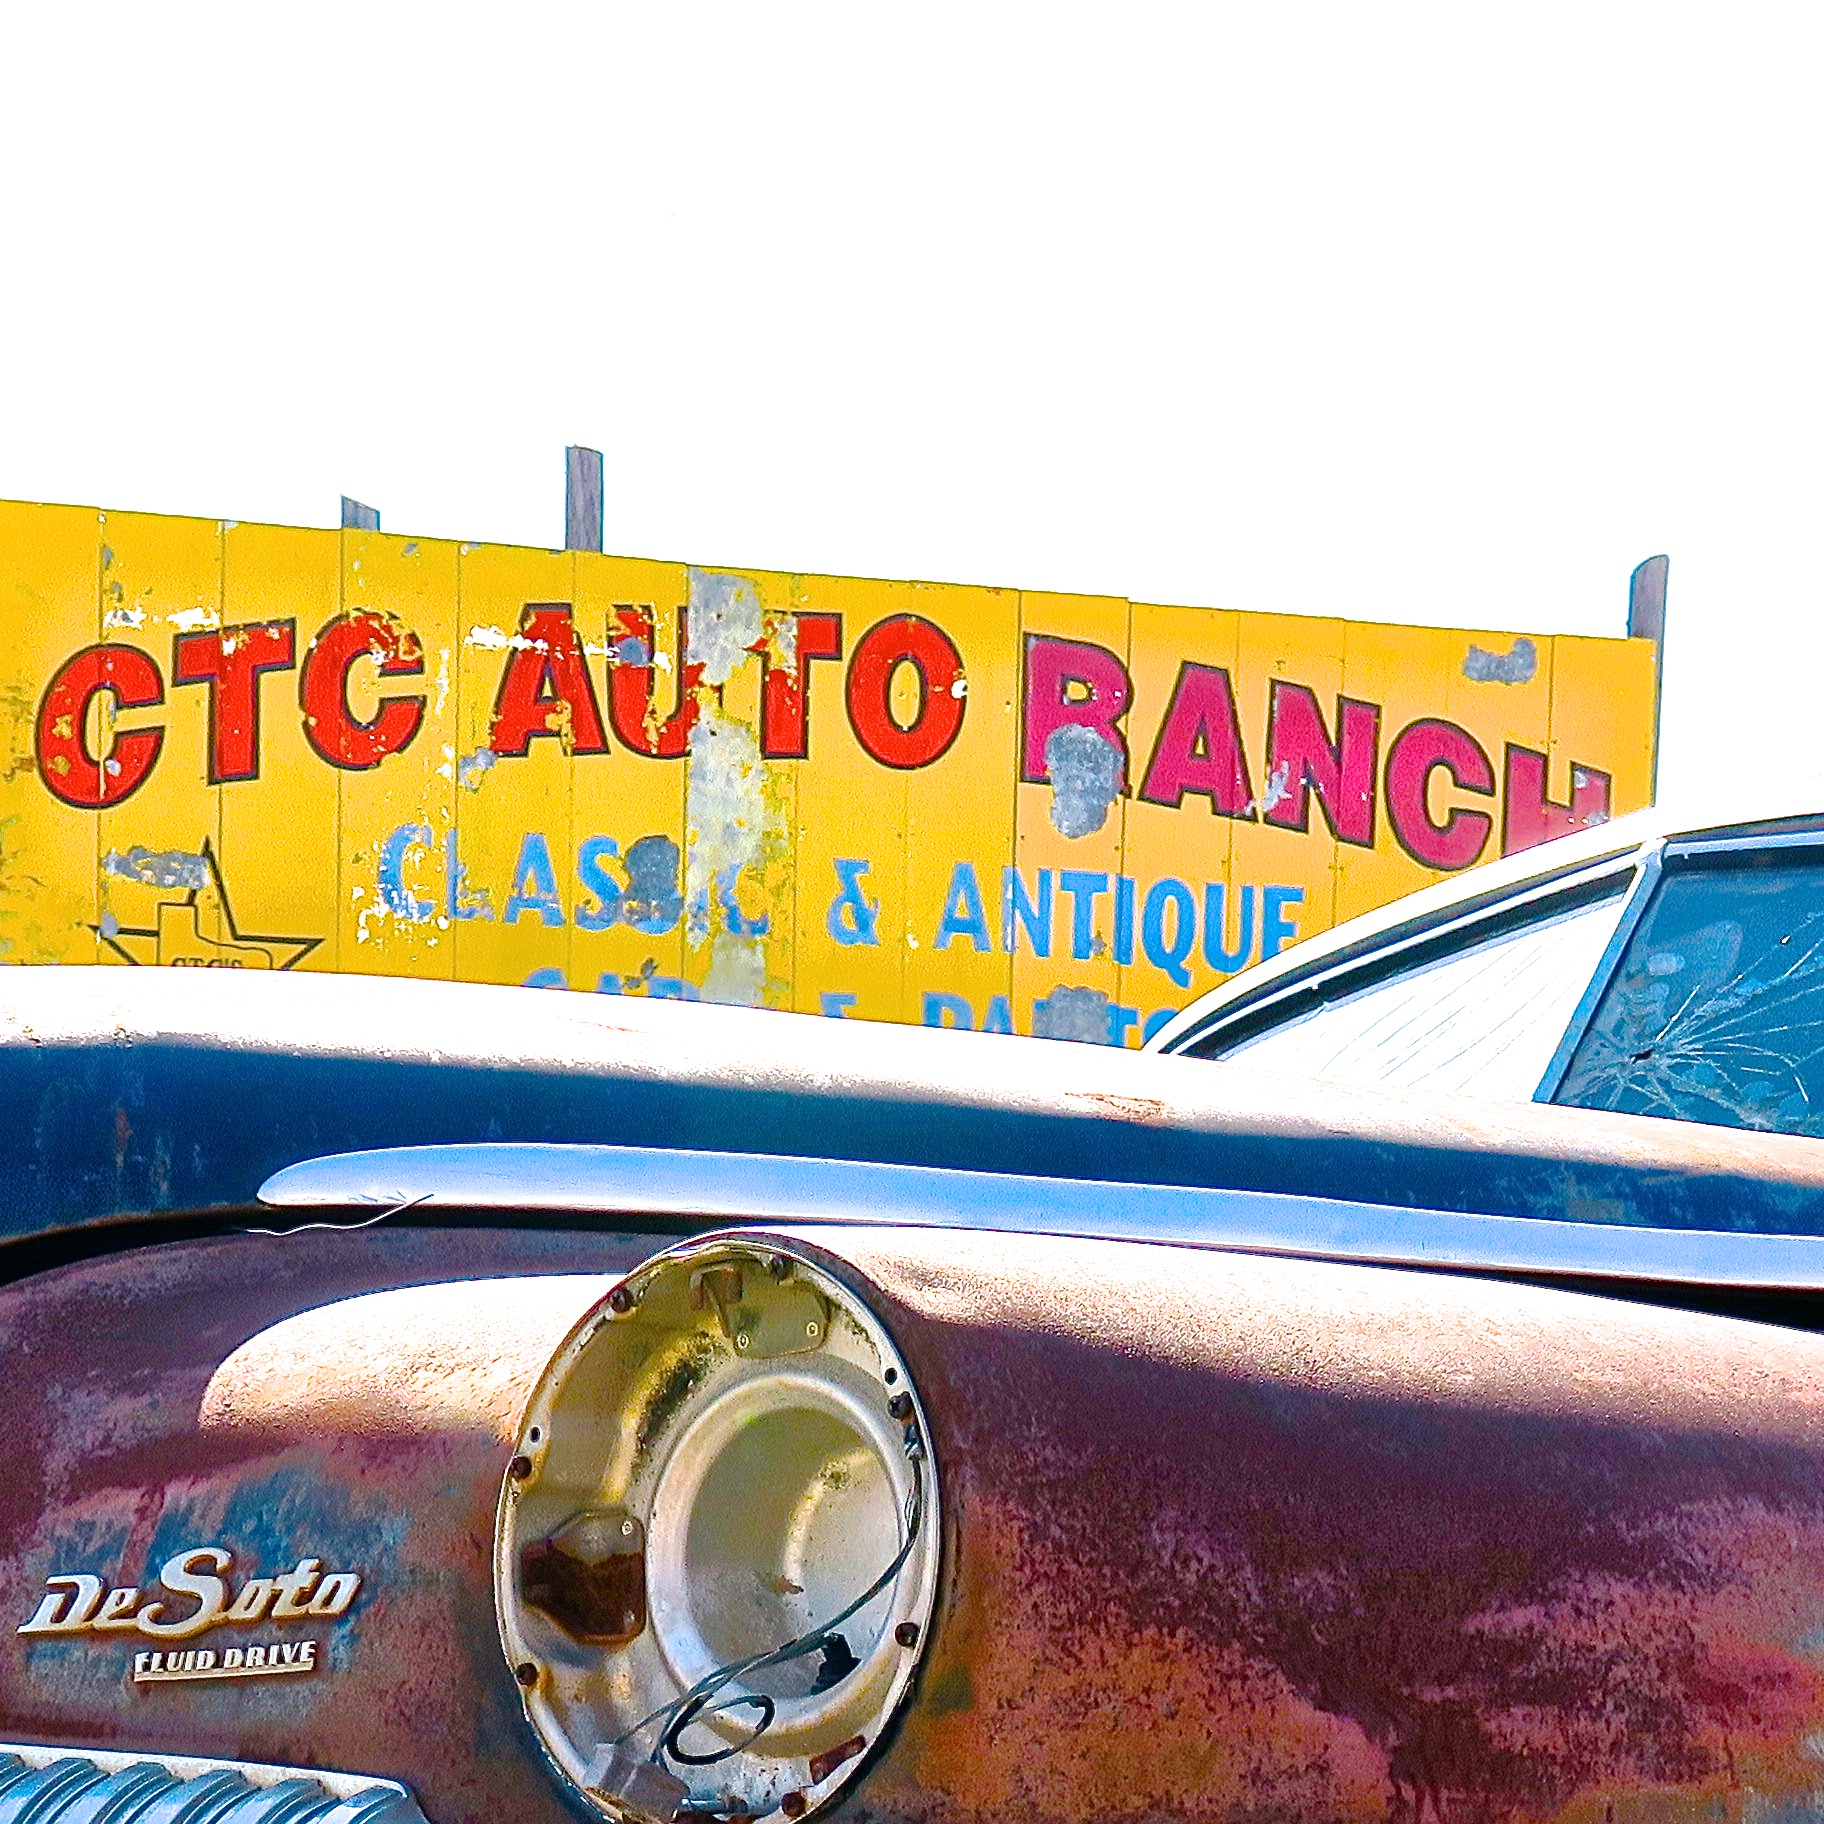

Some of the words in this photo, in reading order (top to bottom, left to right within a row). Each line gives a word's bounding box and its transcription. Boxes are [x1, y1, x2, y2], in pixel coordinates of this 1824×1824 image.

[34, 606, 428, 809] CTC
[489, 602, 966, 770] AUTO
[1020, 631, 1612, 872] RANCH
[826, 857, 881, 946] &
[932, 861, 1306, 988] ANTIQUE
[134, 1650, 217, 1675] FLUID
[223, 1640, 316, 1670] DRIVE
